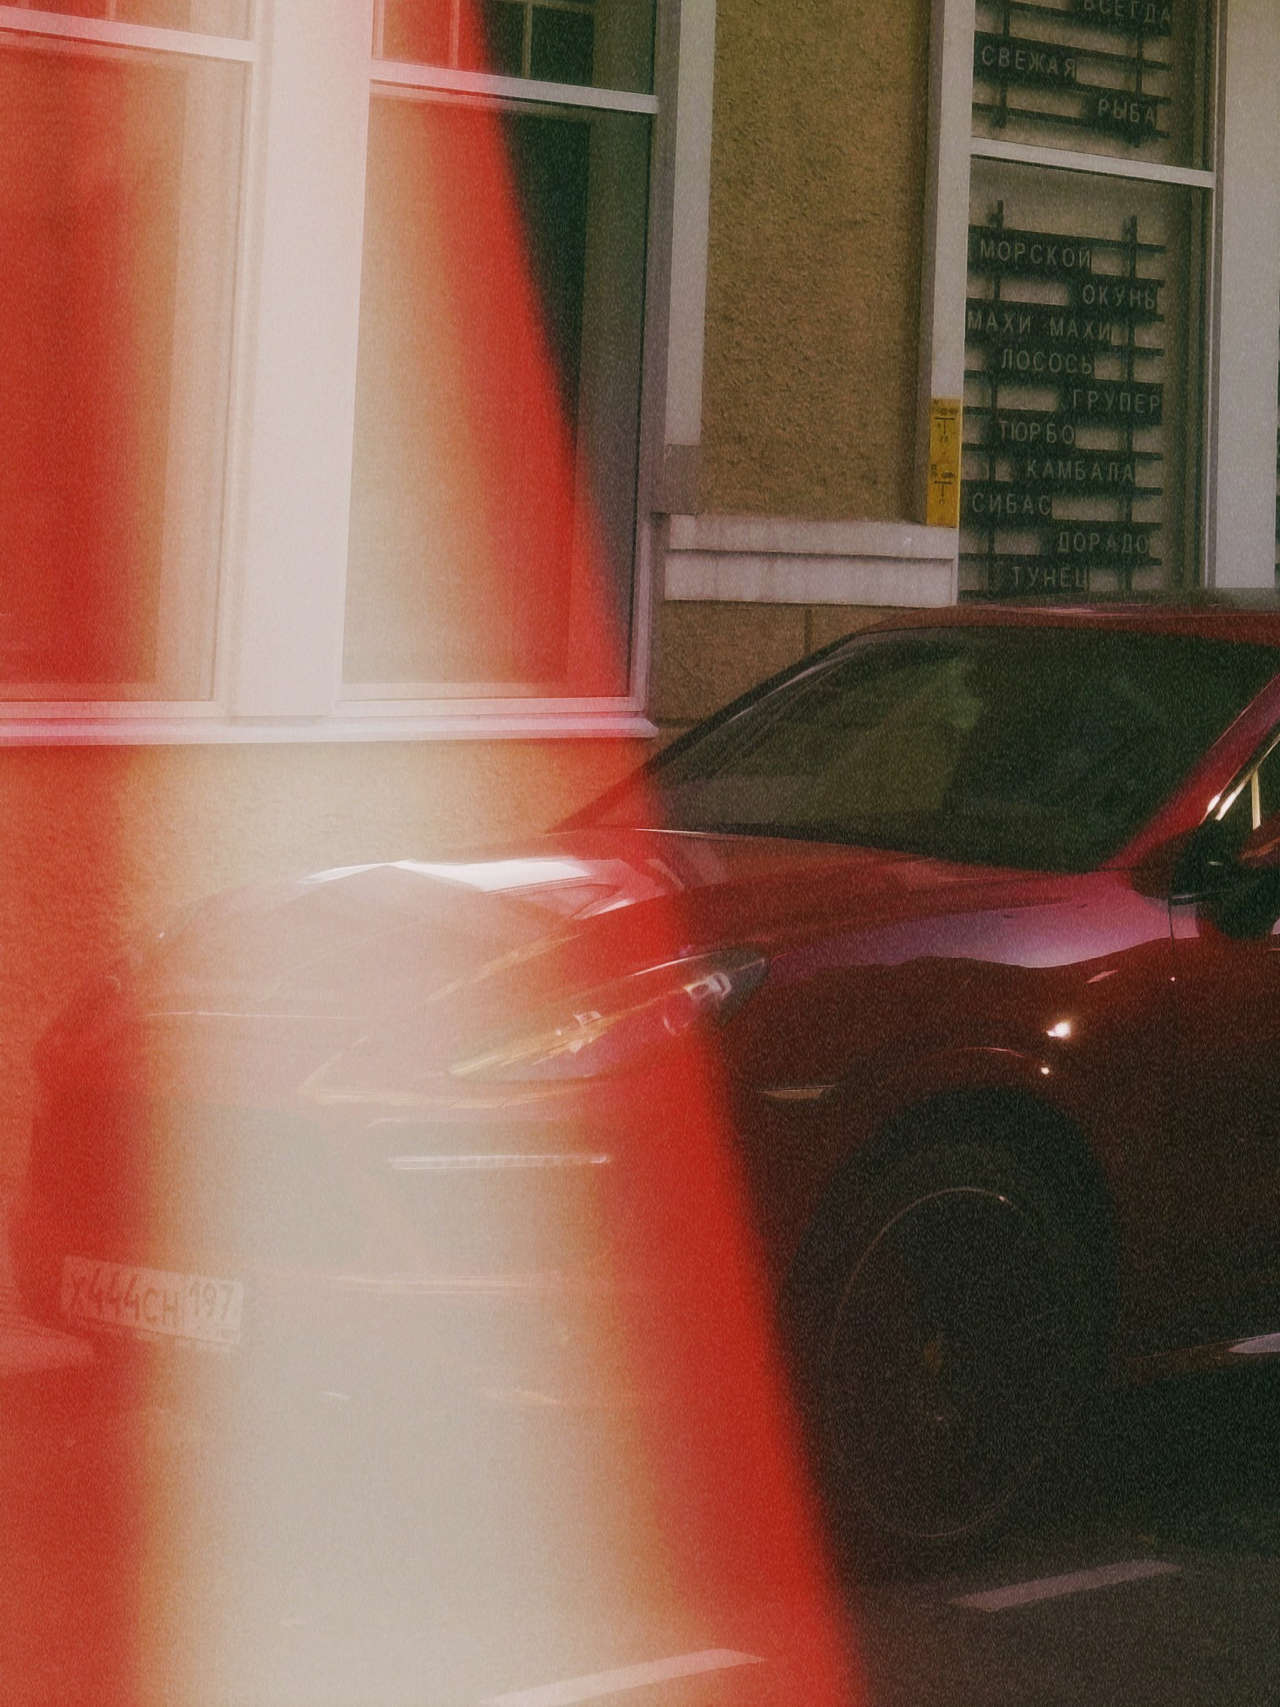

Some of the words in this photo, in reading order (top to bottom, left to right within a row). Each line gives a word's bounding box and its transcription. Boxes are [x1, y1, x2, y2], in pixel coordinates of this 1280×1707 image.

[981, 45, 1077, 78] СВЕЖАЯ
[1097, 98, 1157, 124] РЫБА
[980, 238, 1092, 268] МОРСКОЙ
[1082, 284, 1156, 310] ОКУНЬ
[967, 310, 1031, 334] МАХИ
[1050, 317, 1111, 340] МАХИ
[1001, 348, 1092, 375] ЛОСОСЬ
[1072, 388, 1160, 414] ГРУПЕР
[999, 419, 1075, 444] ТЮРБО
[1027, 459, 1134, 482] КАМБАЛА
[971, 492, 1052, 515] СИБАС
[1057, 532, 1149, 555] ДОРАДО
[1012, 565, 1089, 590] ТУНЕЦ
[189, 1280, 233, 1321] 197
